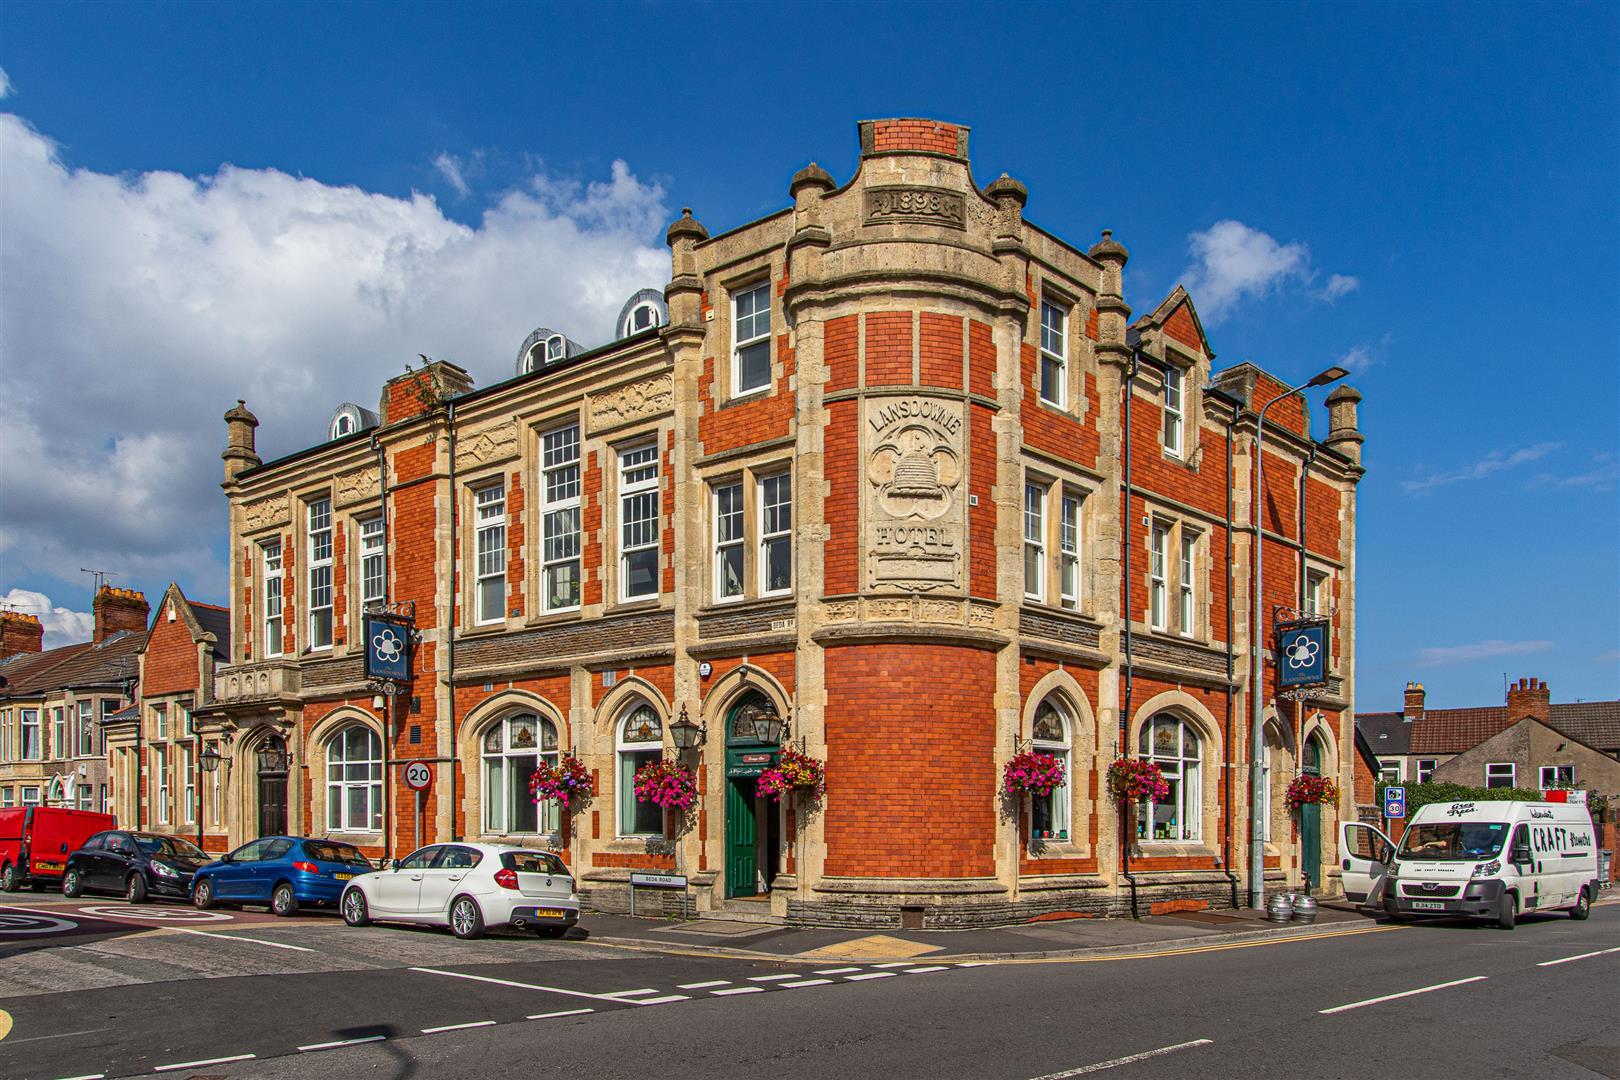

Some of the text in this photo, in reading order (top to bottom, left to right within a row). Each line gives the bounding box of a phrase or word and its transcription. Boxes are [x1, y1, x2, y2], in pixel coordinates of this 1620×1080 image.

[891, 193, 940, 211] 1898
[868, 400, 961, 436] LANSDOWNE
[877, 527, 953, 547] HOTEL
[410, 768, 428, 781] 20
[1533, 826, 1566, 852] CRAFT
